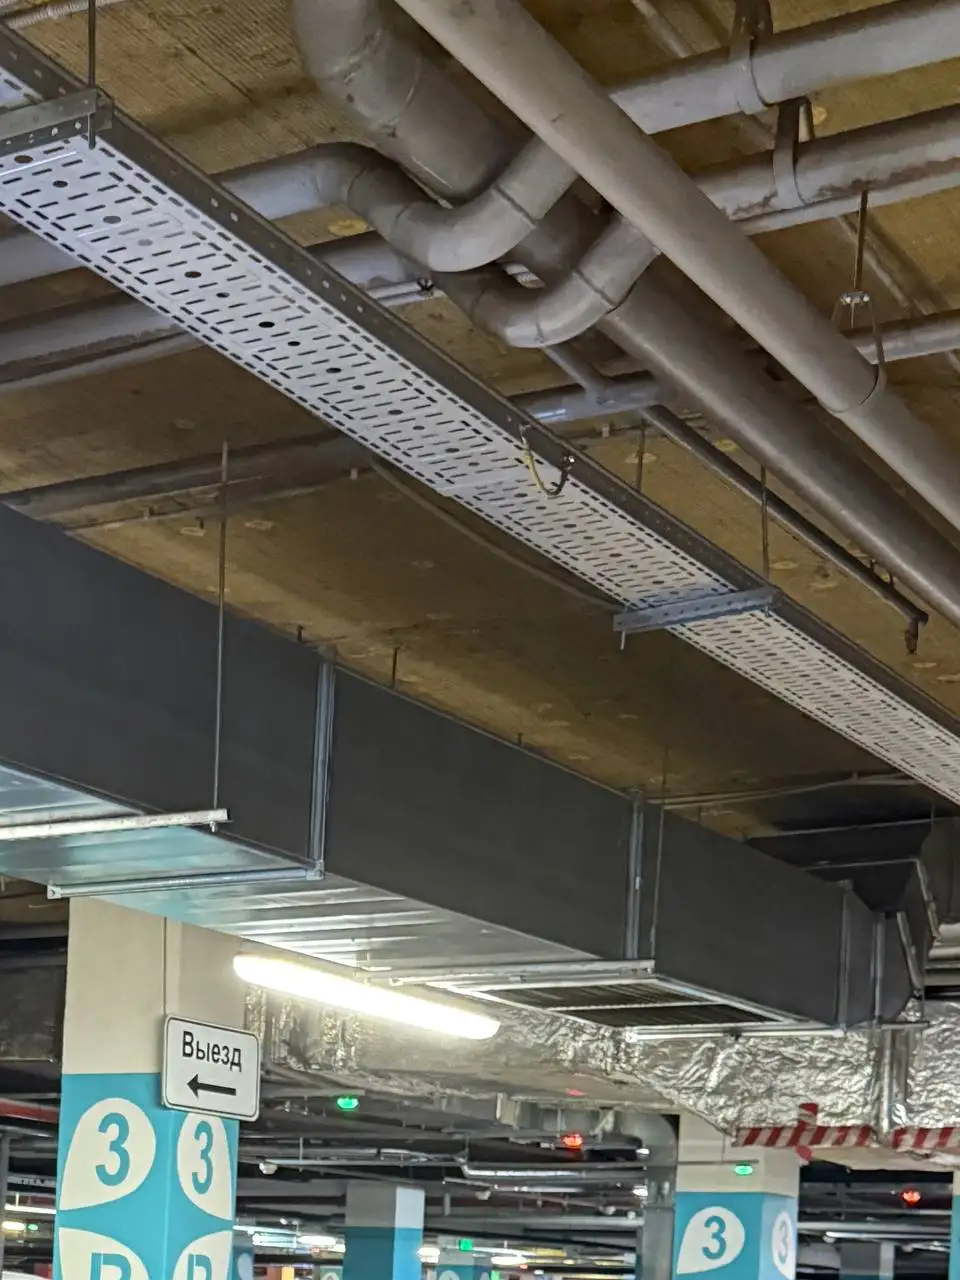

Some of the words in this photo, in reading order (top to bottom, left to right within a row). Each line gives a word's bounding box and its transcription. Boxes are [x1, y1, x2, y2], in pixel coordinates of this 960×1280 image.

[181, 1030, 242, 1073] Выезд
[95, 1111, 131, 1187] 3
[191, 1120, 214, 1195] 3
[701, 1215, 727, 1260] 3
[778, 1219, 788, 1264] 3
